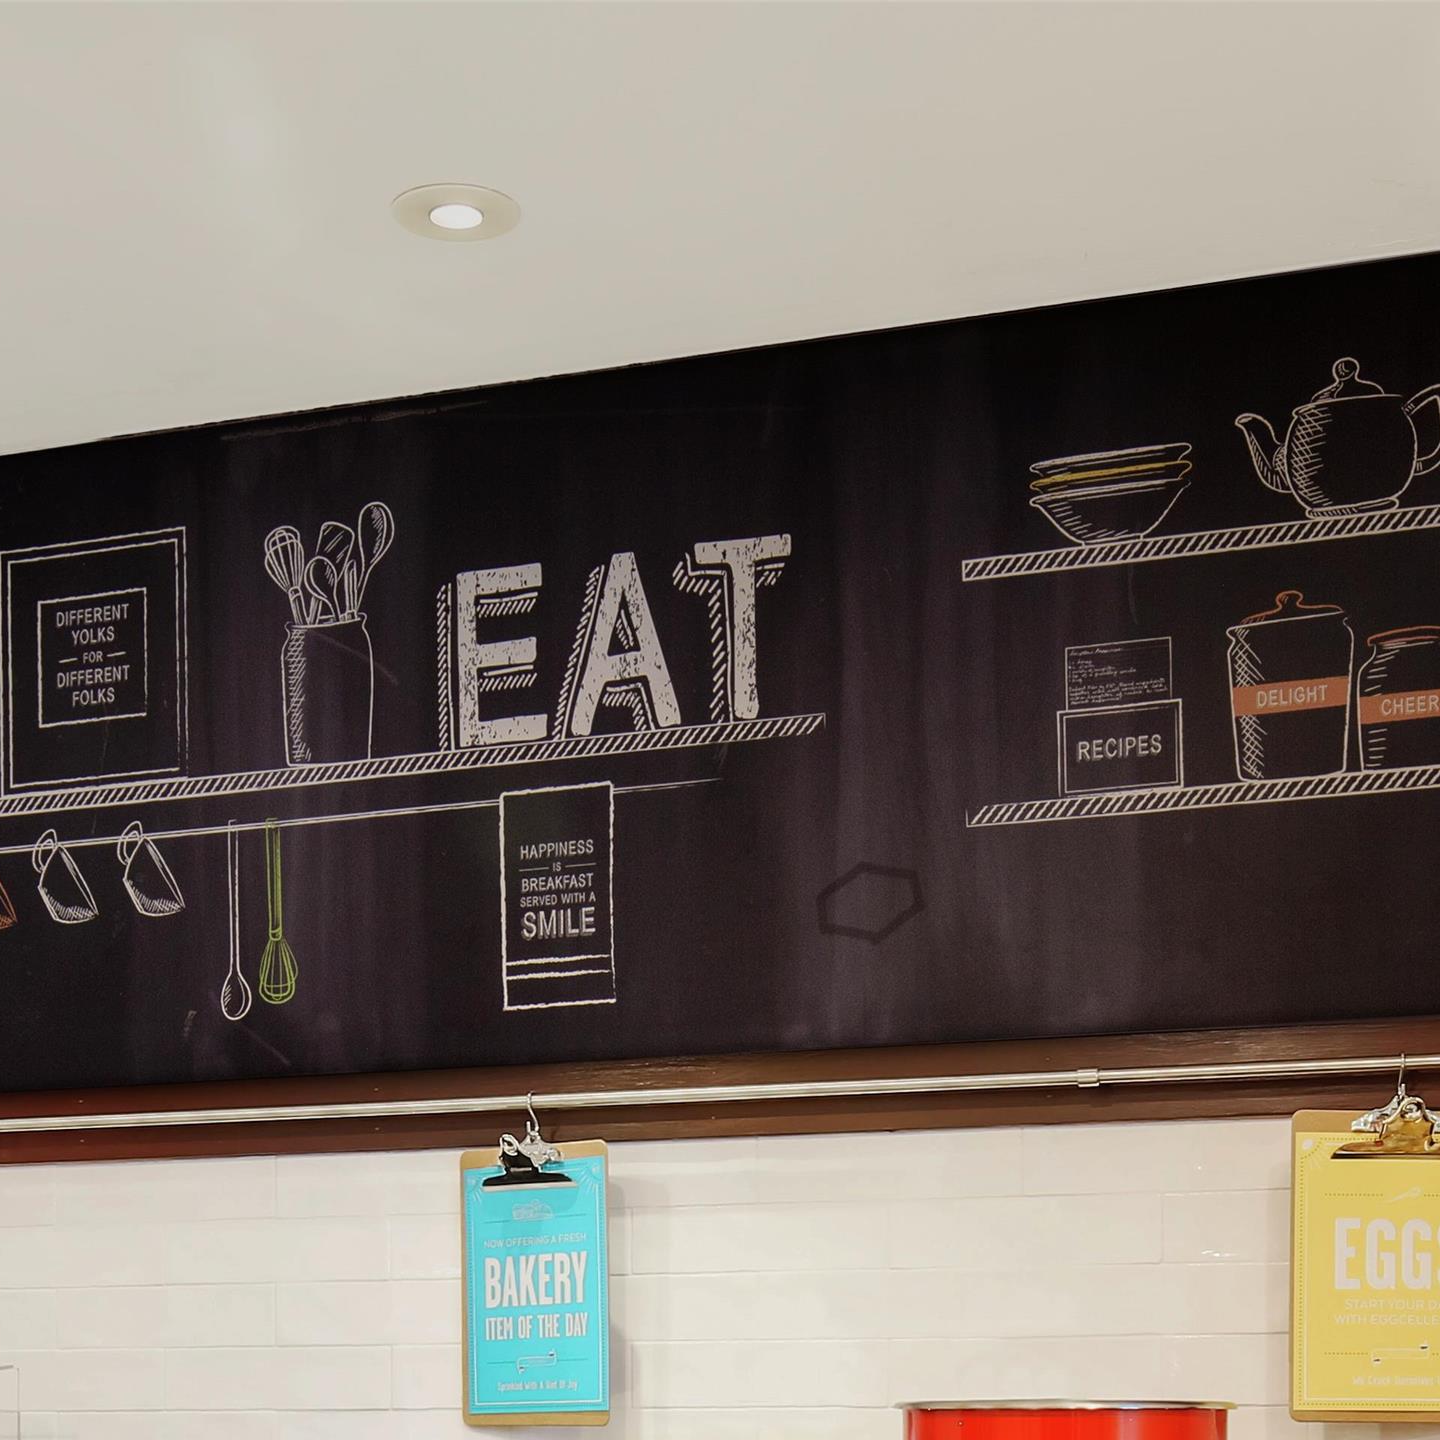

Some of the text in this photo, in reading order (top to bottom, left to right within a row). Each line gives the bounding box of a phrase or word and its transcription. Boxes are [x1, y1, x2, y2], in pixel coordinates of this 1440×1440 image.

[56, 603, 129, 628] DIFFERENT
[72, 626, 115, 646] YOLKS
[437, 533, 792, 750] EAT
[83, 651, 104, 664] FOR
[57, 665, 130, 688] DIFFERENT
[72, 687, 115, 707] FOLKS
[1255, 684, 1329, 710] DELIGHT
[1380, 694, 1440, 716] CHEER
[1077, 733, 1163, 762] RECIPES
[520, 839, 594, 860] HAPPINESS
[552, 862, 562, 872] IS
[521, 873, 594, 892] BREAKFAST
[520, 891, 596, 908] SERVED WITH A
[521, 906, 596, 940] SMILE
[484, 1239, 504, 1250] NOW
[504, 1235, 550, 1249] OFFERING
[558, 1231, 587, 1243] FRESH
[484, 1250, 588, 1309] BAKERY
[1344, 1299, 1385, 1311] START
[1390, 1299, 1425, 1311] YOUR
[485, 1312, 588, 1341] ITEM OF THE DAY
[1335, 1313, 1368, 1326] WITH
